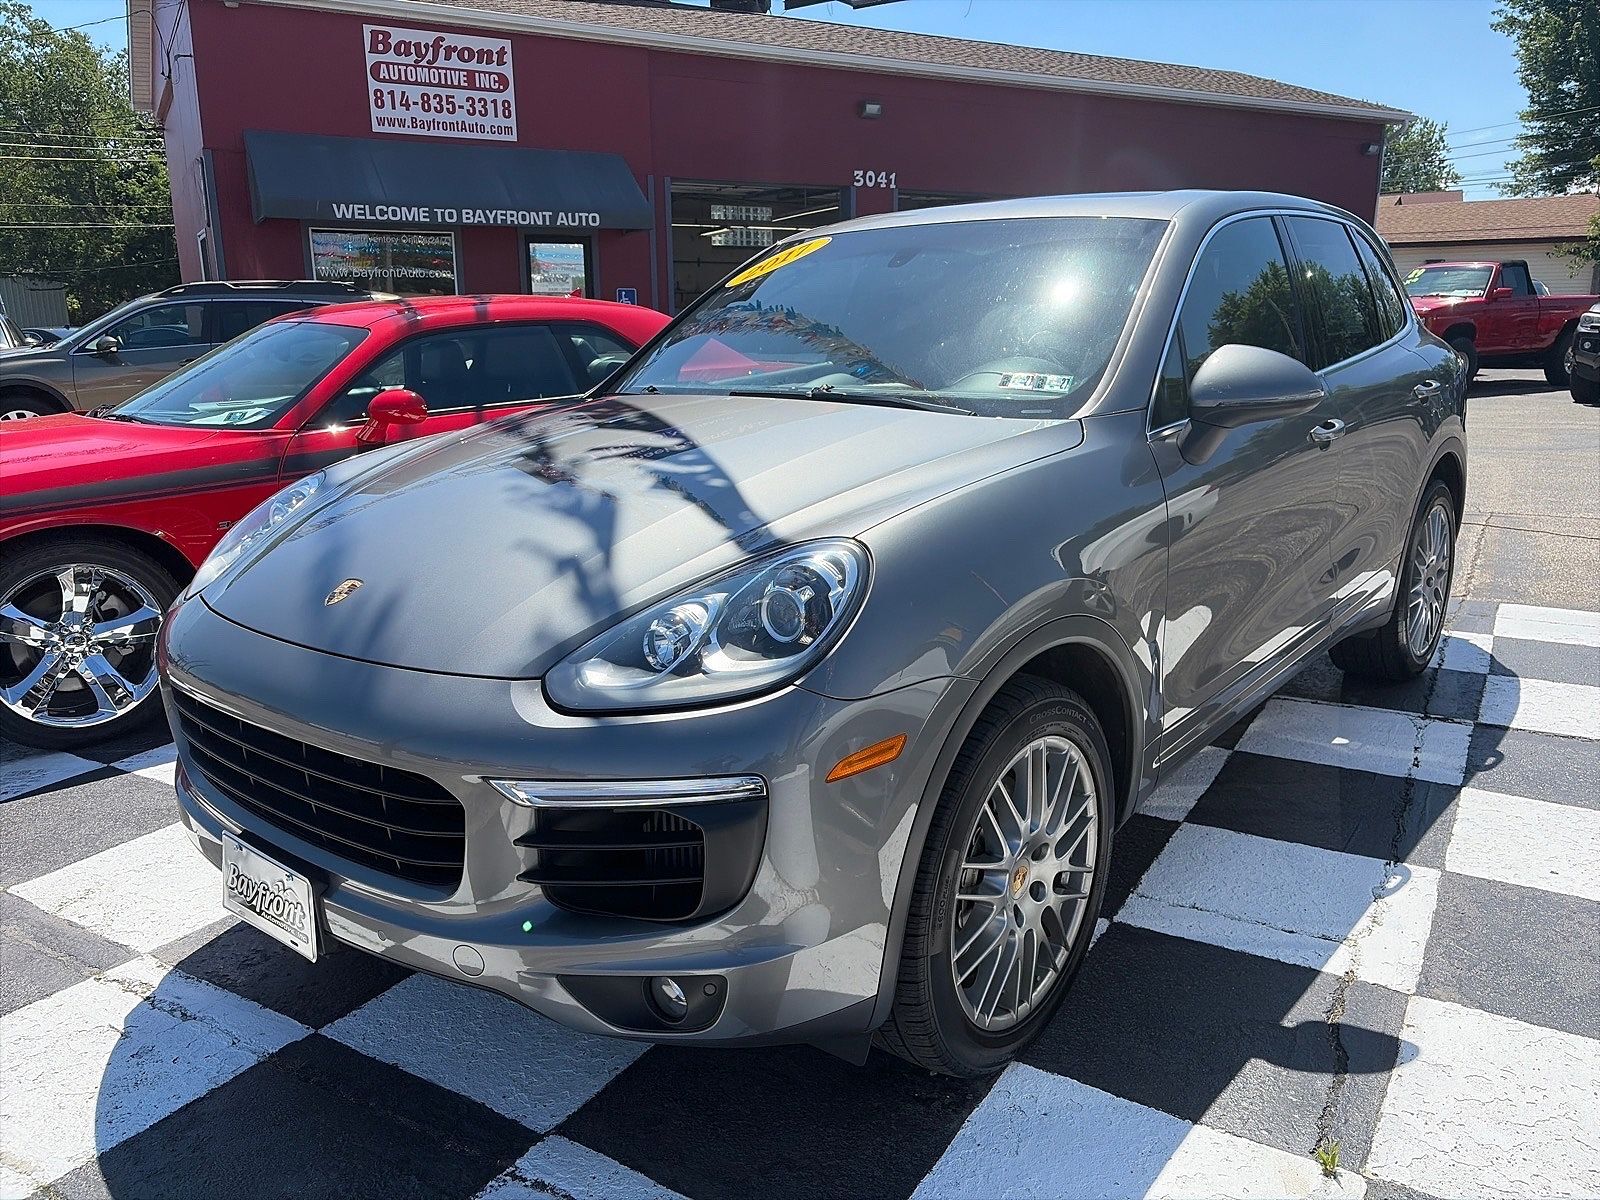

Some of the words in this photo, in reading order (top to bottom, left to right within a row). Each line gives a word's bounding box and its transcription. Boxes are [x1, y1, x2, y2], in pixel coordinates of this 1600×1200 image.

[368, 29, 508, 66] Bayfront
[379, 64, 468, 87] AUTOMOTIVE
[475, 72, 504, 90] INC.
[373, 88, 513, 119] 814-835-3318
[376, 115, 514, 136] www.BayfrontAuto.com
[853, 170, 897, 189] 3041
[332, 203, 430, 222] WELCOME
[434, 208, 458, 222] TO
[462, 209, 552, 226] BAYFRONT
[556, 212, 600, 227] AUTO
[739, 243, 813, 281] 2017
[227, 862, 305, 931] Bayfront
